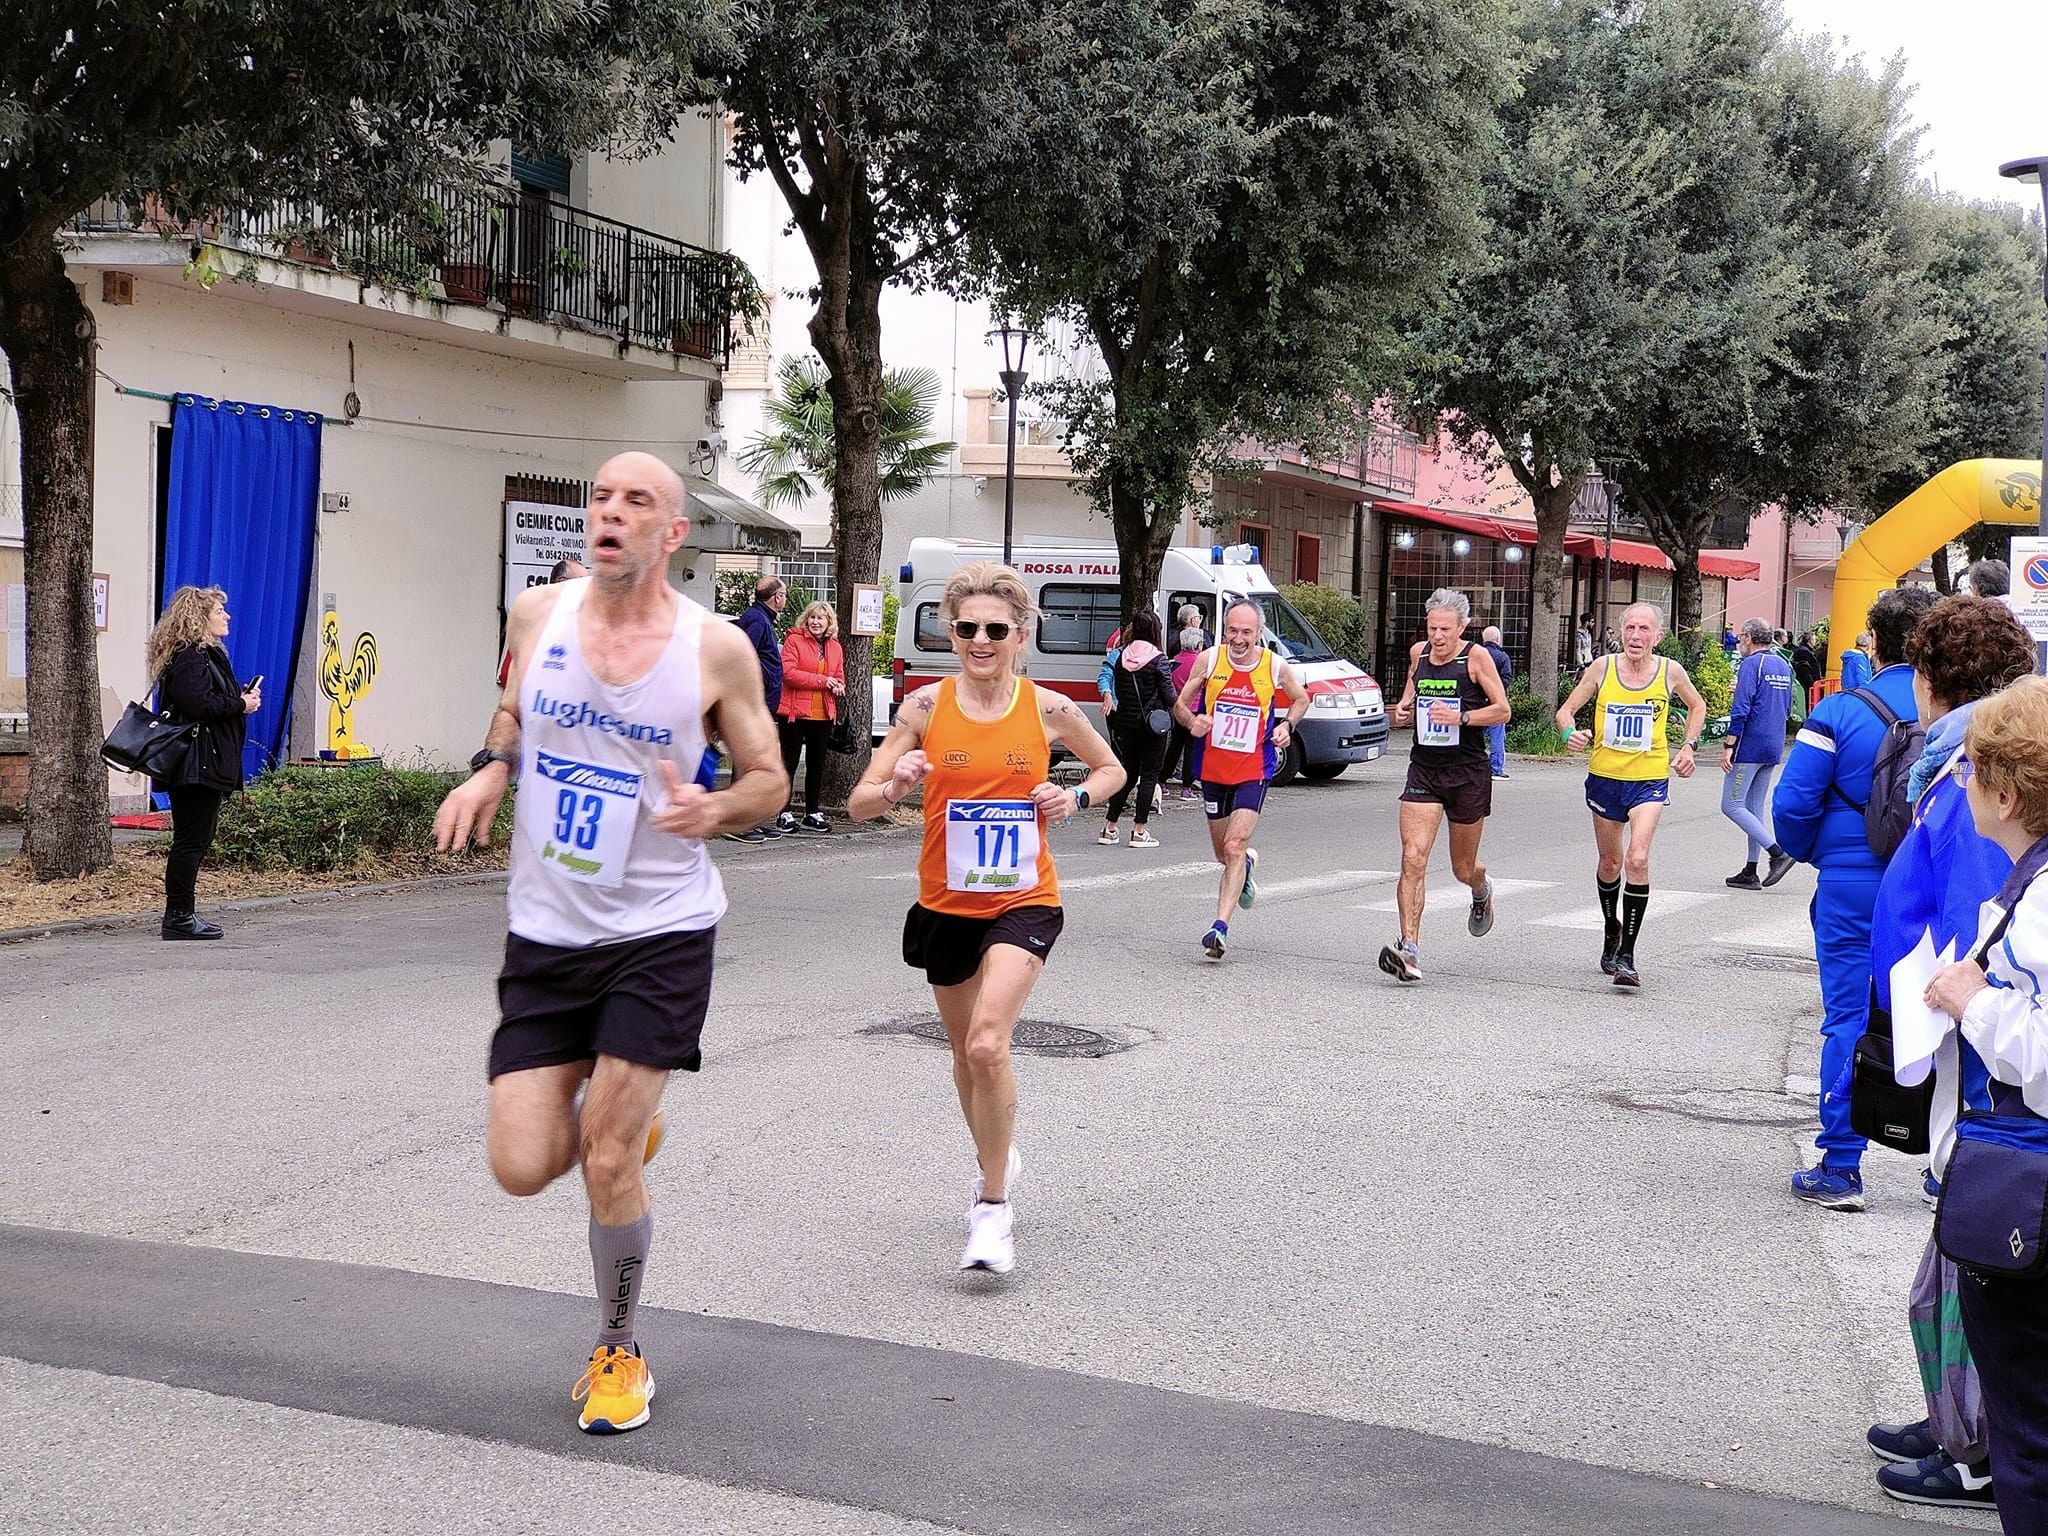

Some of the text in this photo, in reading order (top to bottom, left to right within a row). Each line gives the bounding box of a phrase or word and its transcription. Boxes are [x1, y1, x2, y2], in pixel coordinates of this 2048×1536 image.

[1024, 564, 1073, 575] ROSSA
[532, 688, 674, 747] lughesina
[1223, 715, 1250, 739] 217
[1615, 715, 1644, 738] 100
[944, 753, 968, 763] LUCCI
[556, 788, 604, 851] 93
[974, 824, 1019, 868] 171
[607, 1255, 642, 1330] kalenji
